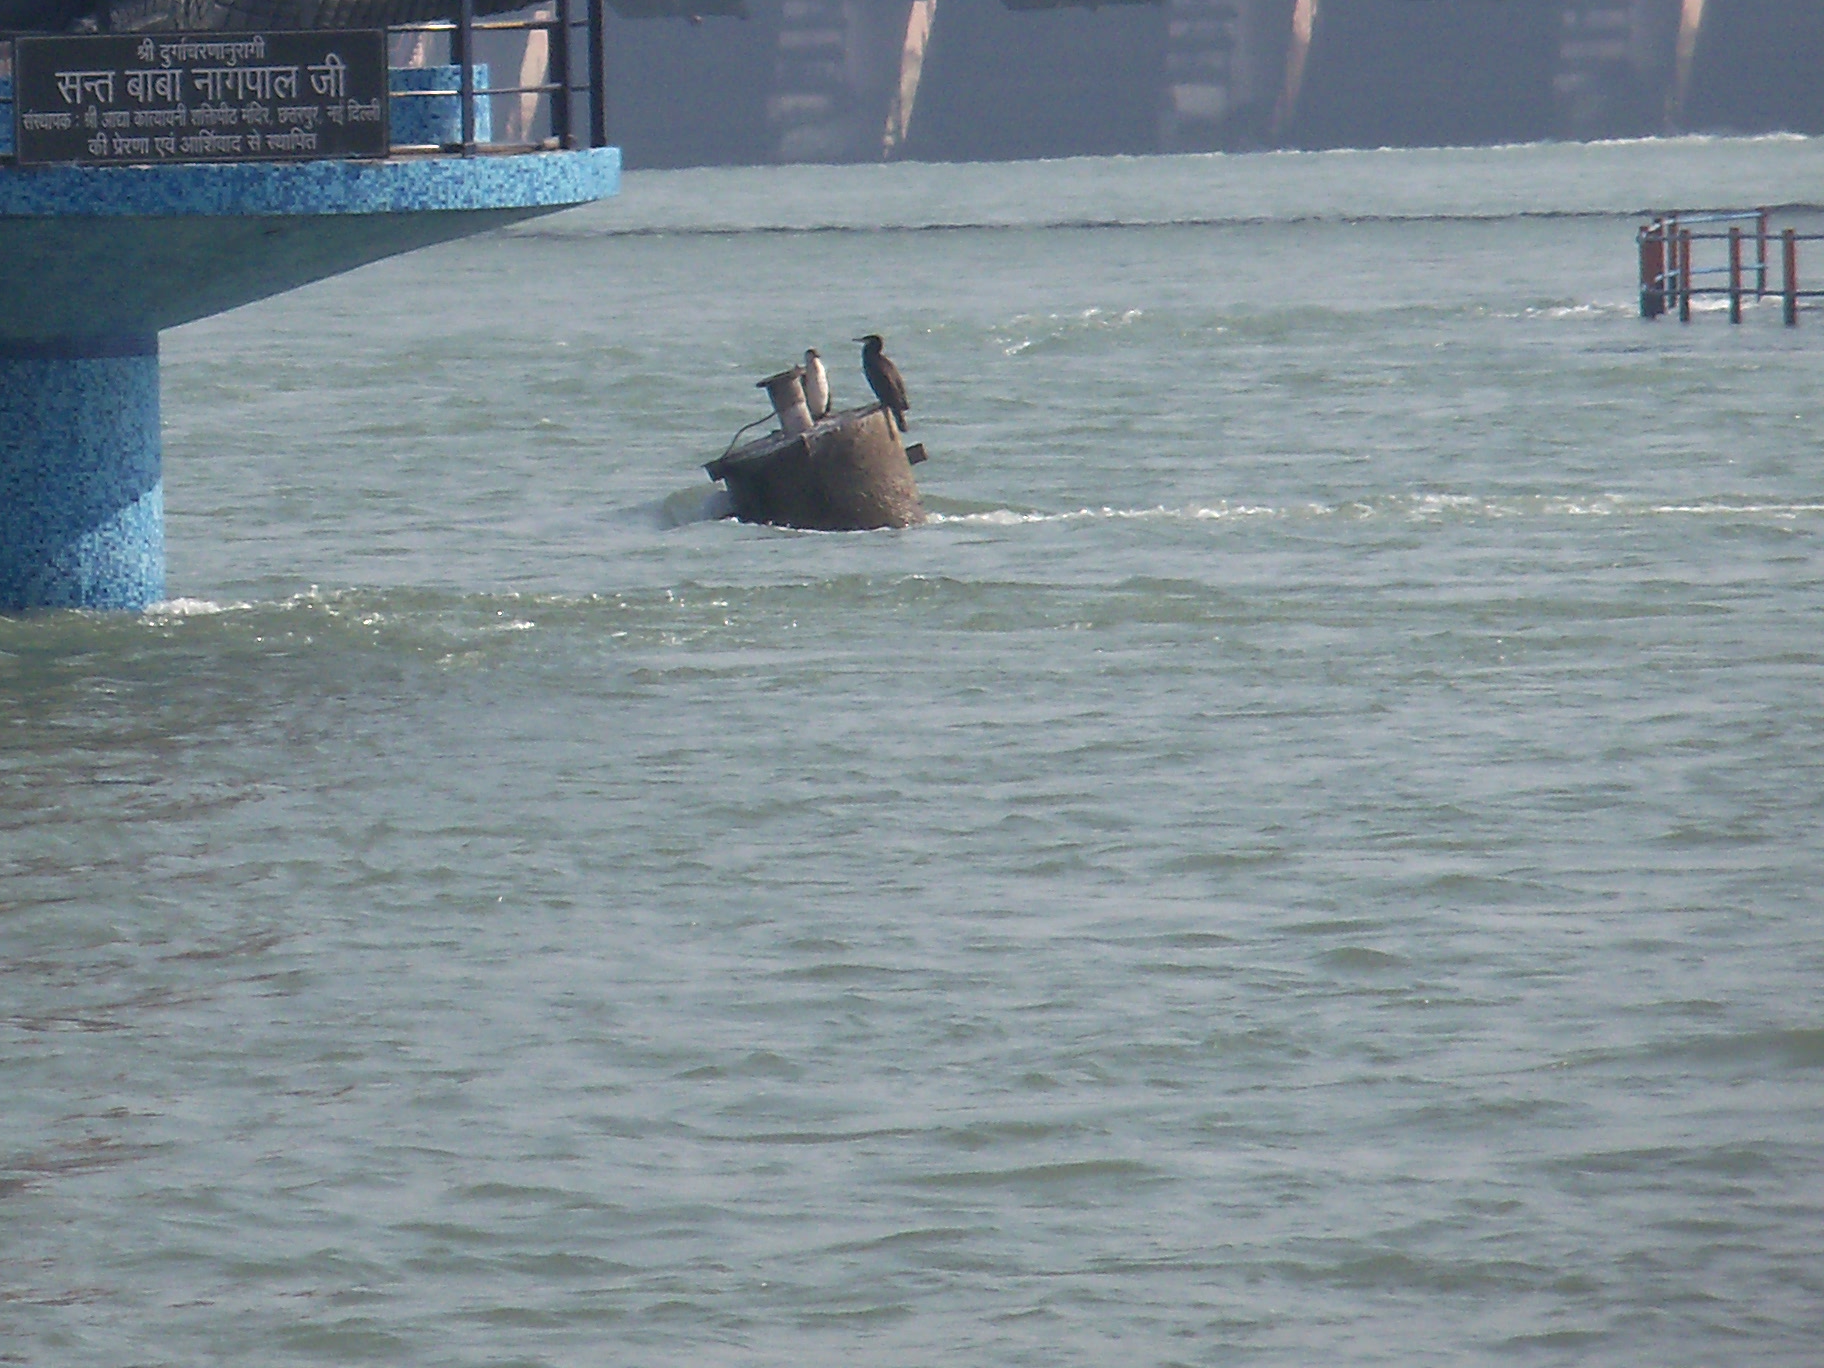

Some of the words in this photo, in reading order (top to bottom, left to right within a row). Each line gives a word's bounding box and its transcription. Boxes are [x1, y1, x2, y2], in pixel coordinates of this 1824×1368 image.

[137, 38, 154, 62] श्री
[55, 71, 116, 104] सन्त
[124, 68, 183, 103] बाबा
[191, 66, 299, 100] नागपाल
[307, 53, 346, 97] जी
[84, 105, 97, 128] श्री
[347, 97, 381, 122] दिल्ली
[88, 132, 108, 156] की
[112, 132, 149, 155] प्रेरणा
[154, 132, 176, 157] एवं
[246, 128, 261, 151] से
